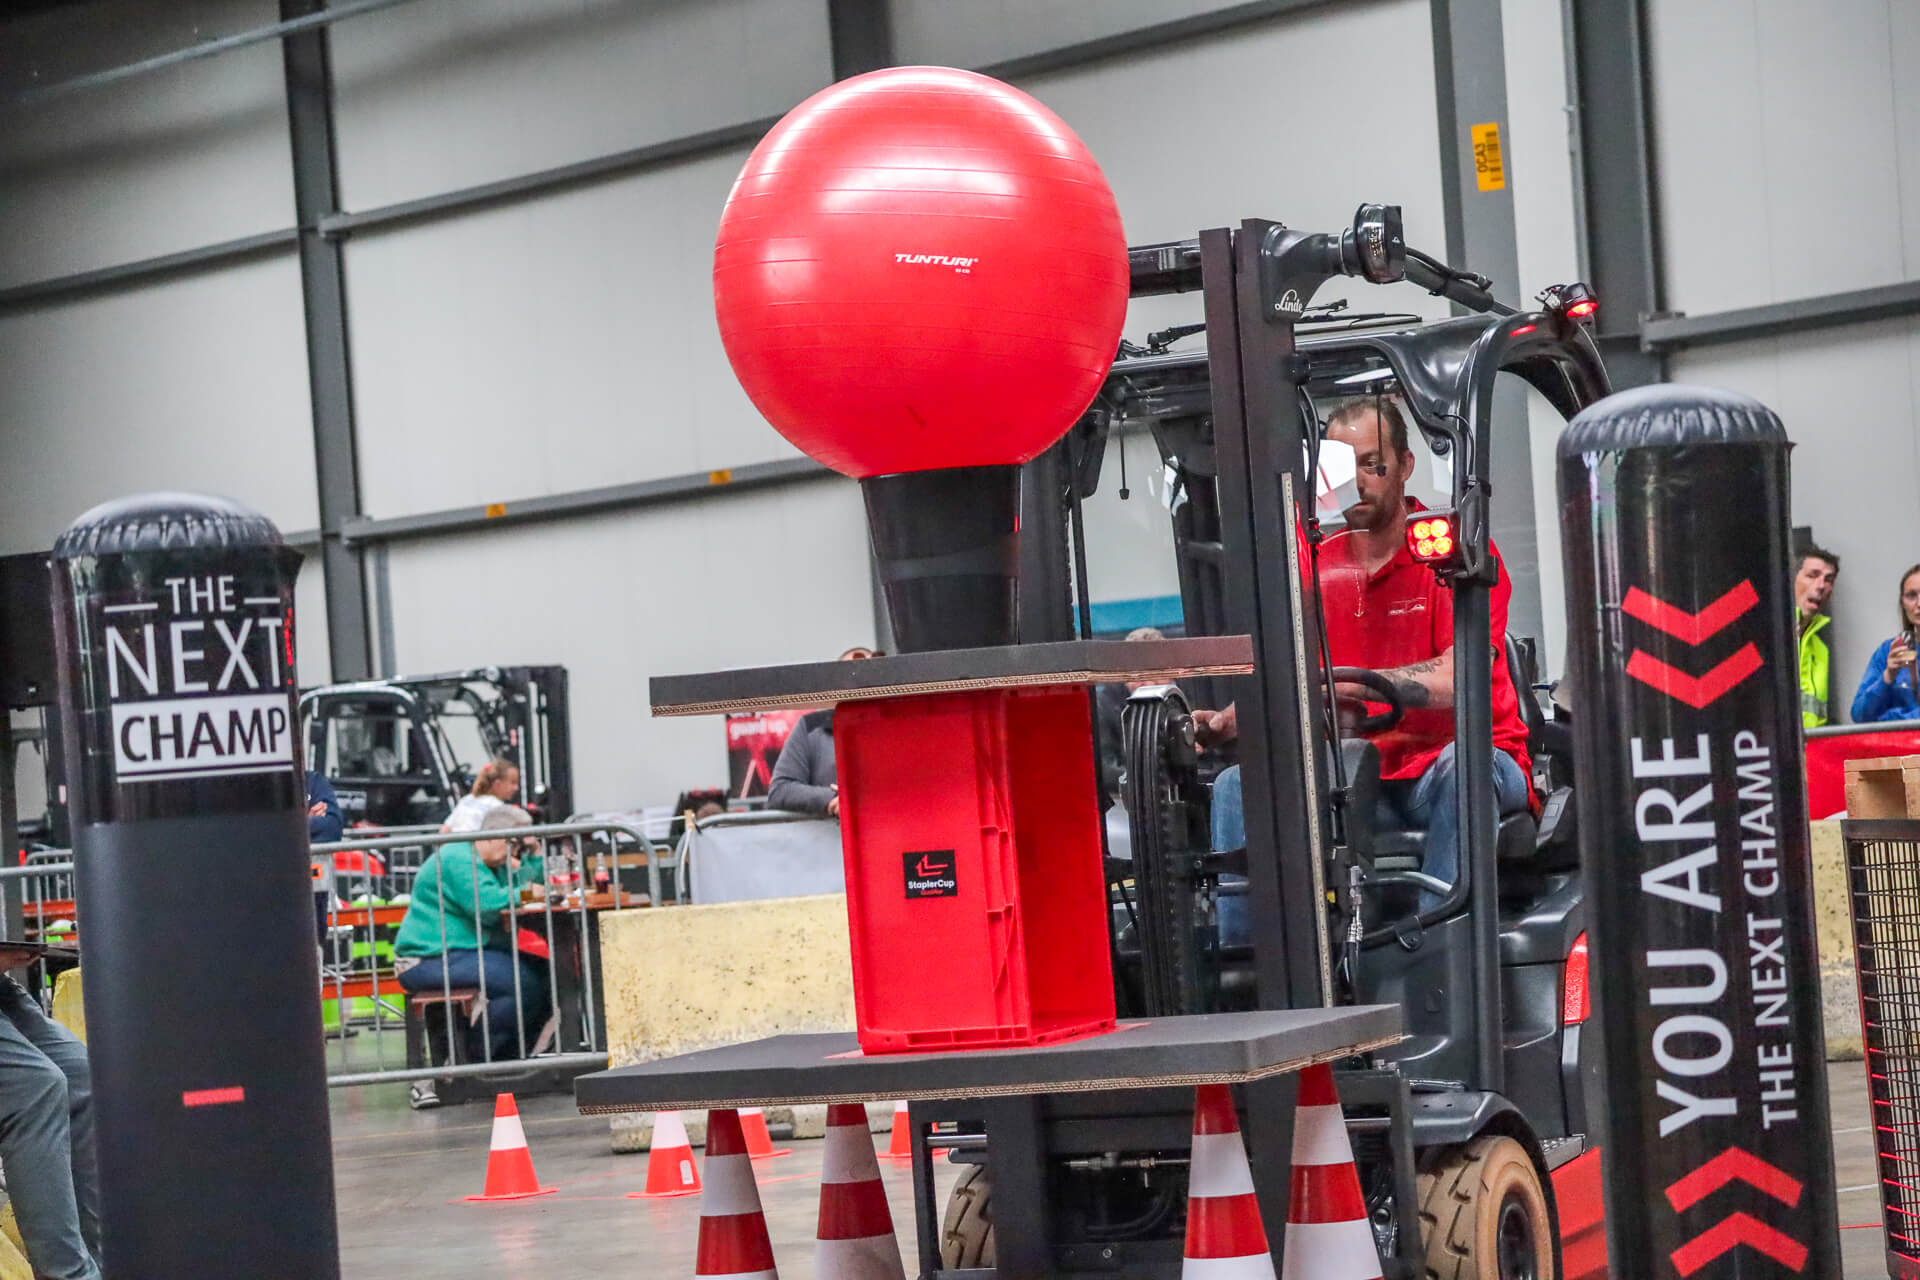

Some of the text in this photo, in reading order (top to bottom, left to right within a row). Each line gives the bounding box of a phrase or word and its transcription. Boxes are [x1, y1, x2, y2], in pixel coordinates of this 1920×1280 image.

[895, 253, 972, 267] TUNTURI
[1275, 289, 1303, 314] Linde
[165, 575, 236, 614] THE
[105, 617, 283, 698] NEXT
[120, 706, 287, 762] CHAMP
[908, 879, 955, 890] StaplerCup
[1631, 733, 1738, 1138] YOU ARE
[1734, 730, 1798, 1129] THE NEXT CHAMP
